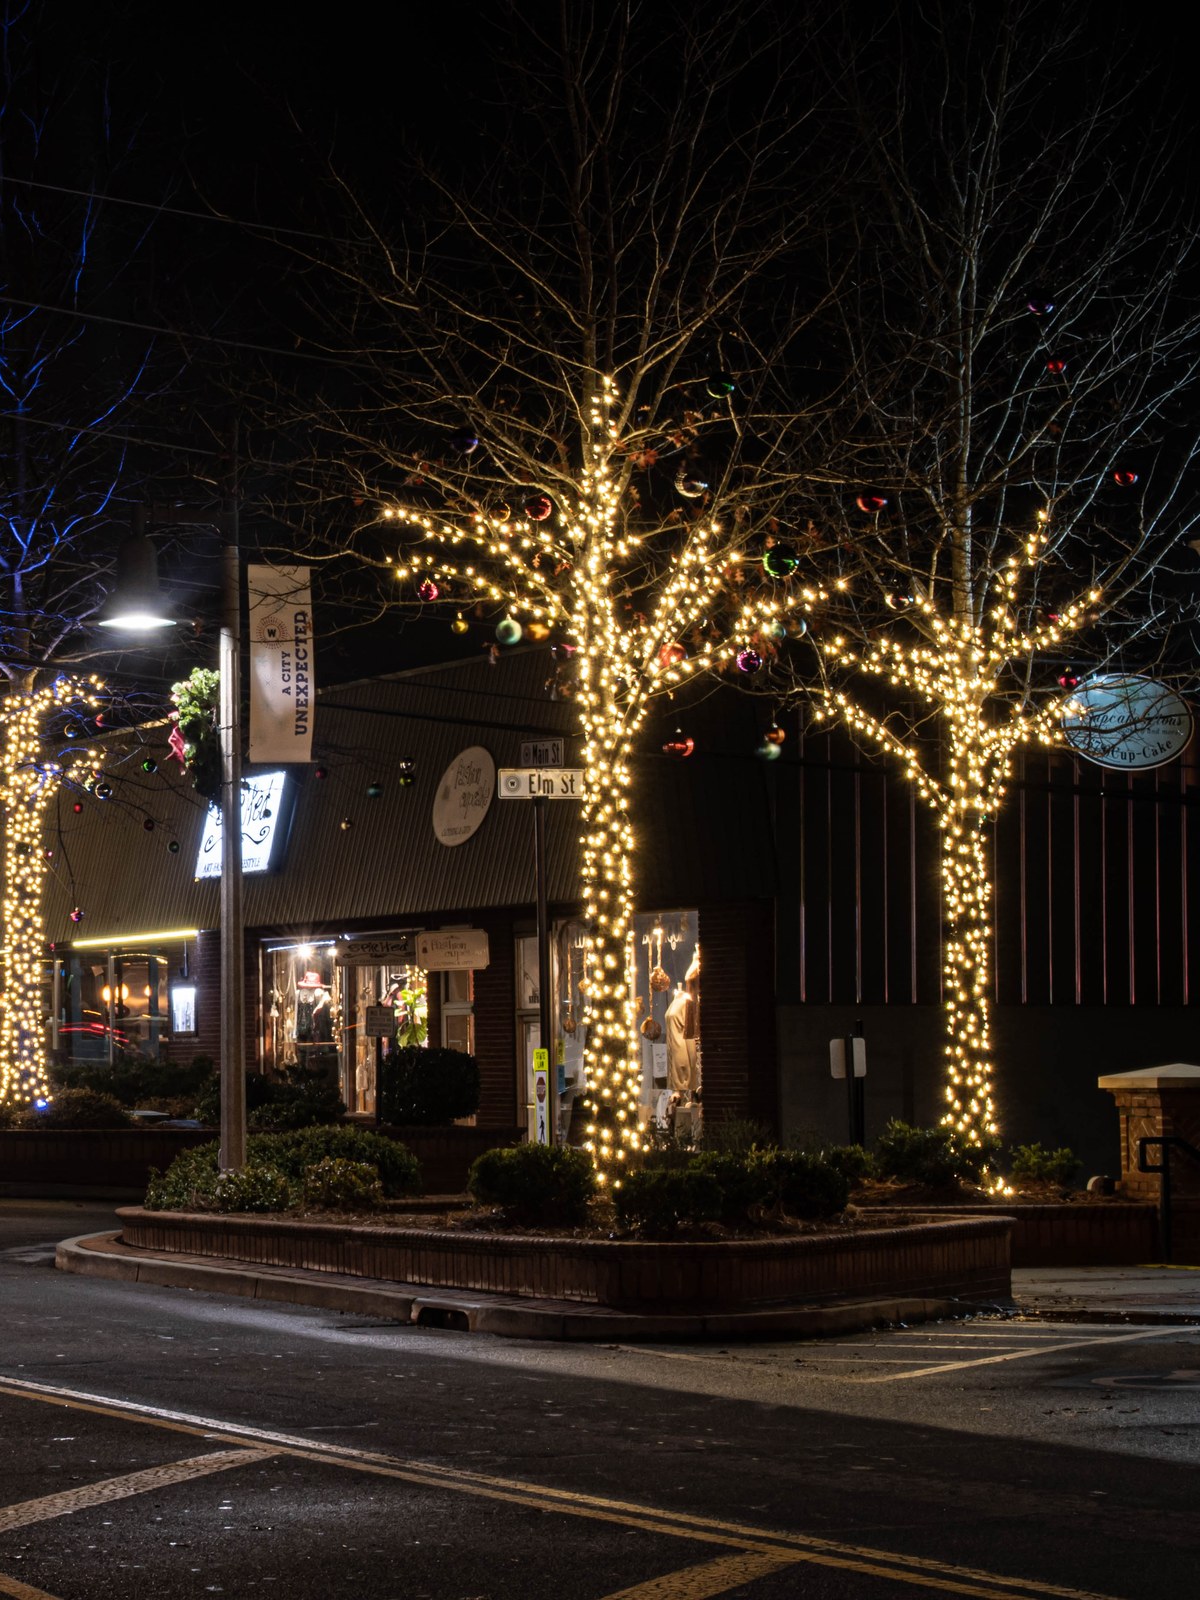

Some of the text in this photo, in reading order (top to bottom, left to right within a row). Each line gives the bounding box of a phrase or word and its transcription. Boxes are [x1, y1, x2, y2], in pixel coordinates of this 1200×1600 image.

[281, 651, 291, 696] A CITY
[294, 611, 308, 736] UNEXPECTED
[532, 742, 560, 765] Main St
[529, 773, 575, 794] Elm St
